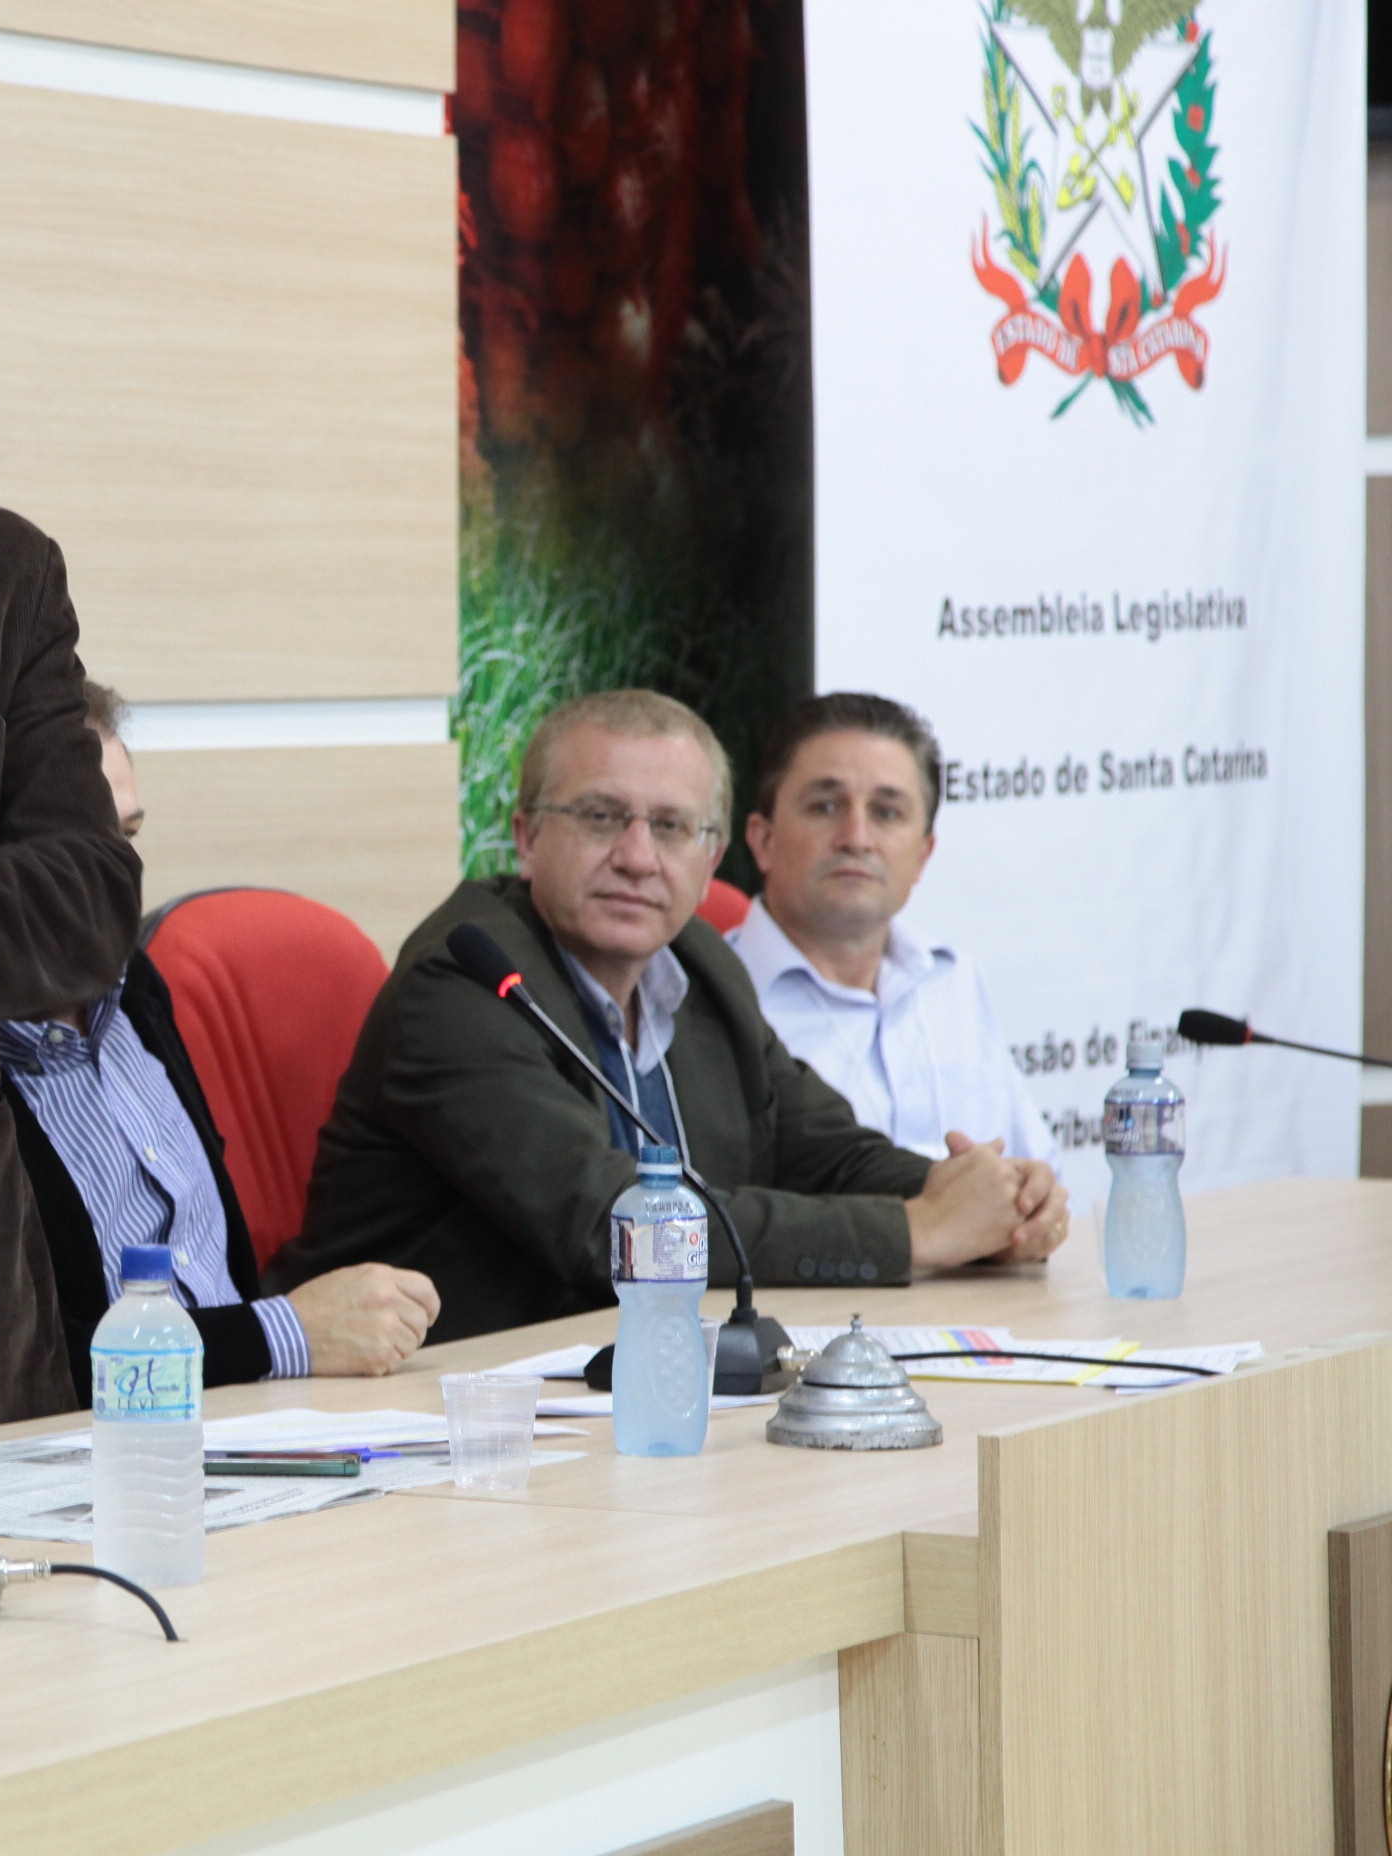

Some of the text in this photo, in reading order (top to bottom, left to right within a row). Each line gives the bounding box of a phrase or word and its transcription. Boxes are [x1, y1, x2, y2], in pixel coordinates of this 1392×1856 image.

[938, 588, 1248, 642] Assembleia Legislativa
[945, 740, 1268, 802] Estado de Santa Catarina
[1086, 1023, 1117, 1066] de
[117, 1397, 161, 1410] LEVE
